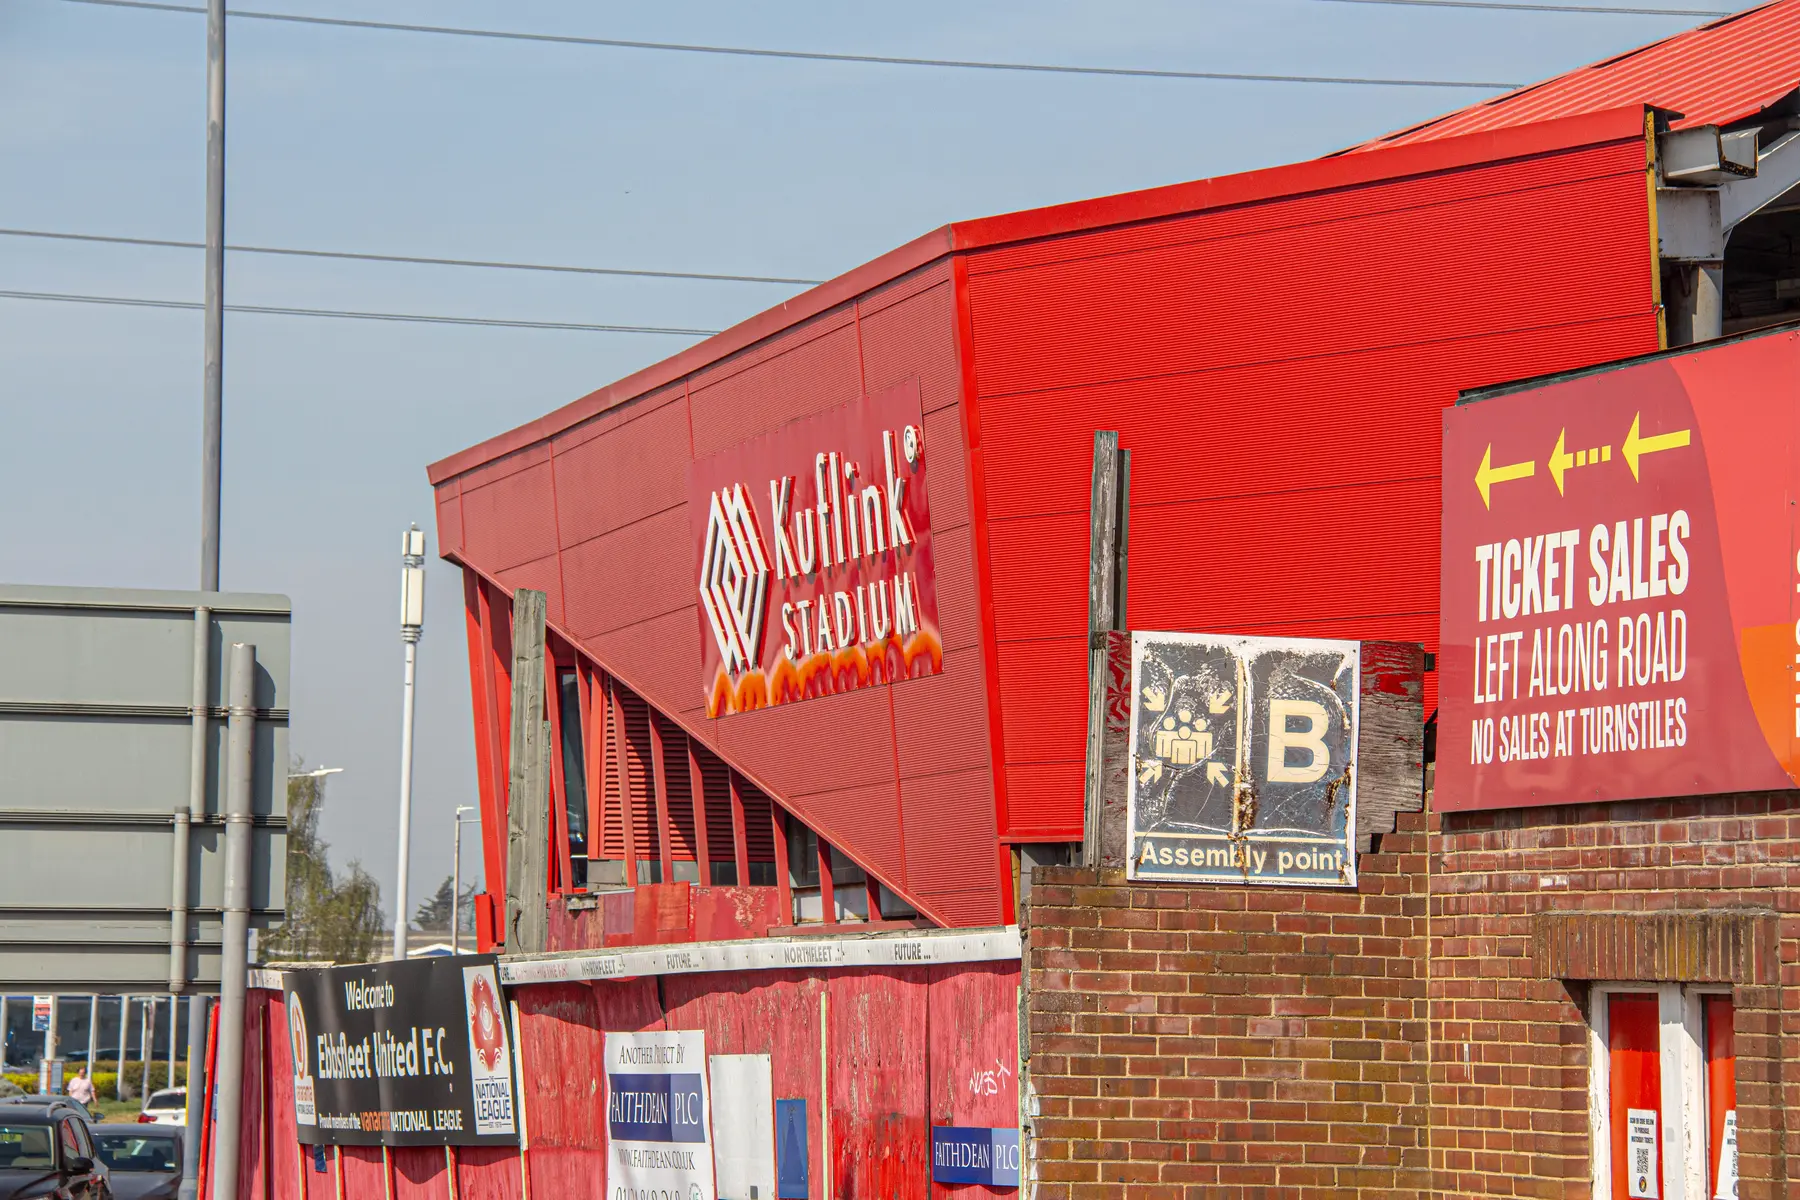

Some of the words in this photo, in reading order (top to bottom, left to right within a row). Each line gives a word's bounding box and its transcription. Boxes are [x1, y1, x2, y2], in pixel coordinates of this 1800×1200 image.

[1475, 528, 1580, 622] TICKET
[1588, 509, 1690, 606] SALES
[782, 571, 917, 660] STADIUM
[1473, 631, 1523, 704] LEFT
[1529, 618, 1609, 698] ALONG
[1617, 609, 1687, 688] ROAD
[1266, 699, 1330, 783] B
[1470, 717, 1494, 764] NO
[1499, 711, 1549, 763] SALES
[1554, 708, 1575, 757] AT
[1580, 697, 1687, 755] TURNSTILES
[1140, 842, 1267, 873] Assembly
[1278, 847, 1343, 874] point
[344, 979, 384, 1010] Welcome
[385, 981, 394, 1008] to
[317, 1031, 371, 1079] Ebbsfleet
[373, 1027, 419, 1078] United
[422, 1026, 453, 1075] F.C.
[475, 1083, 509, 1098] NATIONAL
[390, 1110, 431, 1131] NATIONAL
[433, 1109, 463, 1131] LEAGUE
[477, 1099, 511, 1120] LEAGUE
[611, 1091, 668, 1124] FAITHDEAN
[675, 1092, 698, 1125] PLC
[617, 1148, 696, 1170] WWW.FAITHDEAN.CO.UK
[935, 1142, 990, 1168] FAITHDEAN
[995, 1144, 1019, 1170] PLC
